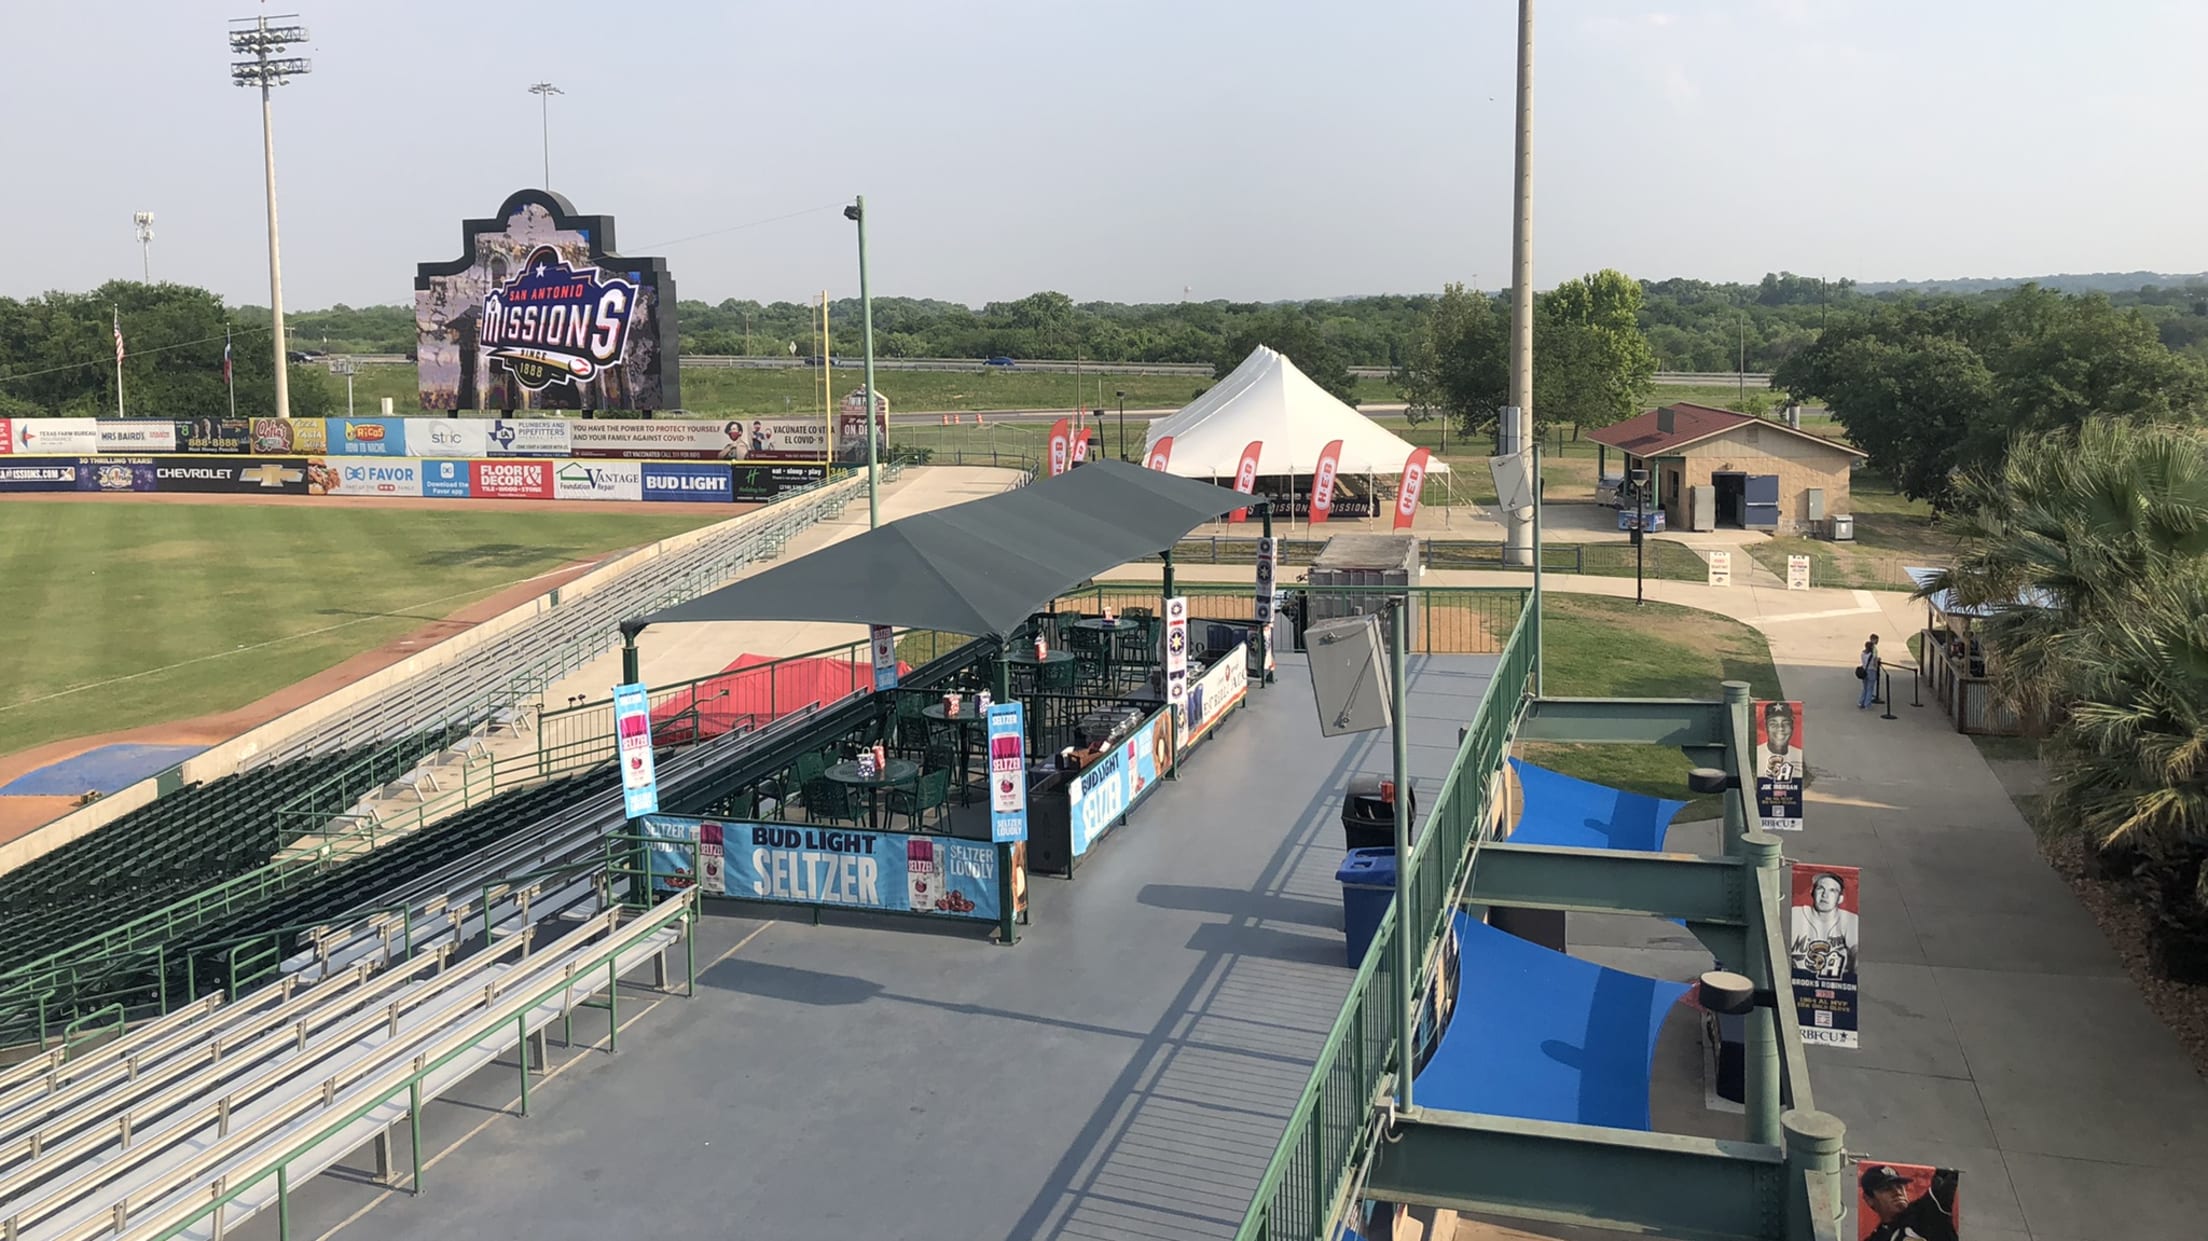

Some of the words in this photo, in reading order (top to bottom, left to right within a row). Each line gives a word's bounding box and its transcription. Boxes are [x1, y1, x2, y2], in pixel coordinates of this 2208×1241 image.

[509, 289, 527, 301] SAN
[531, 284, 584, 299] ANTONIO
[483, 288, 626, 359] MISSIONS
[519, 348, 548, 361] SINCE
[519, 362, 544, 378] 1888
[180, 424, 190, 437] 8
[518, 428, 565, 436] PIPEFITTERS
[655, 425, 686, 433] PROTECT
[687, 425, 721, 433] YOURSELF
[844, 424, 856, 435] ON
[858, 424, 884, 436] DEK
[101, 432, 117, 441] MRS
[118, 432, 146, 441] BAIRD'S
[608, 434, 631, 442] FAMILY
[632, 434, 662, 442] AGAINST
[784, 435, 793, 444] EL
[156, 467, 233, 479] CHEVROLET
[368, 467, 414, 481] FAVOR
[480, 465, 523, 476] FLOOR
[808, 468, 822, 476] play
[427, 481, 460, 489] Download
[480, 475, 523, 487] DECOR
[584, 468, 640, 489] VANTAGE
[645, 476, 680, 490] BUD
[681, 477, 728, 491] LIGHT
[560, 482, 591, 490] Foundation
[597, 483, 616, 491] Repair
[1080, 775, 1098, 796] BUD
[1099, 753, 1120, 784] LIGHT
[645, 823, 685, 839] SELTZER
[752, 827, 802, 849] BUD
[805, 831, 877, 854] LIGHT
[950, 844, 994, 863] SELTZER
[951, 858, 994, 880] LOUDLY
[752, 847, 880, 905] SELTZER
[1792, 978, 1820, 988] BROOKS
[1821, 980, 1857, 991] ROBINSON
[1800, 1028, 1839, 1042] RBFCU
